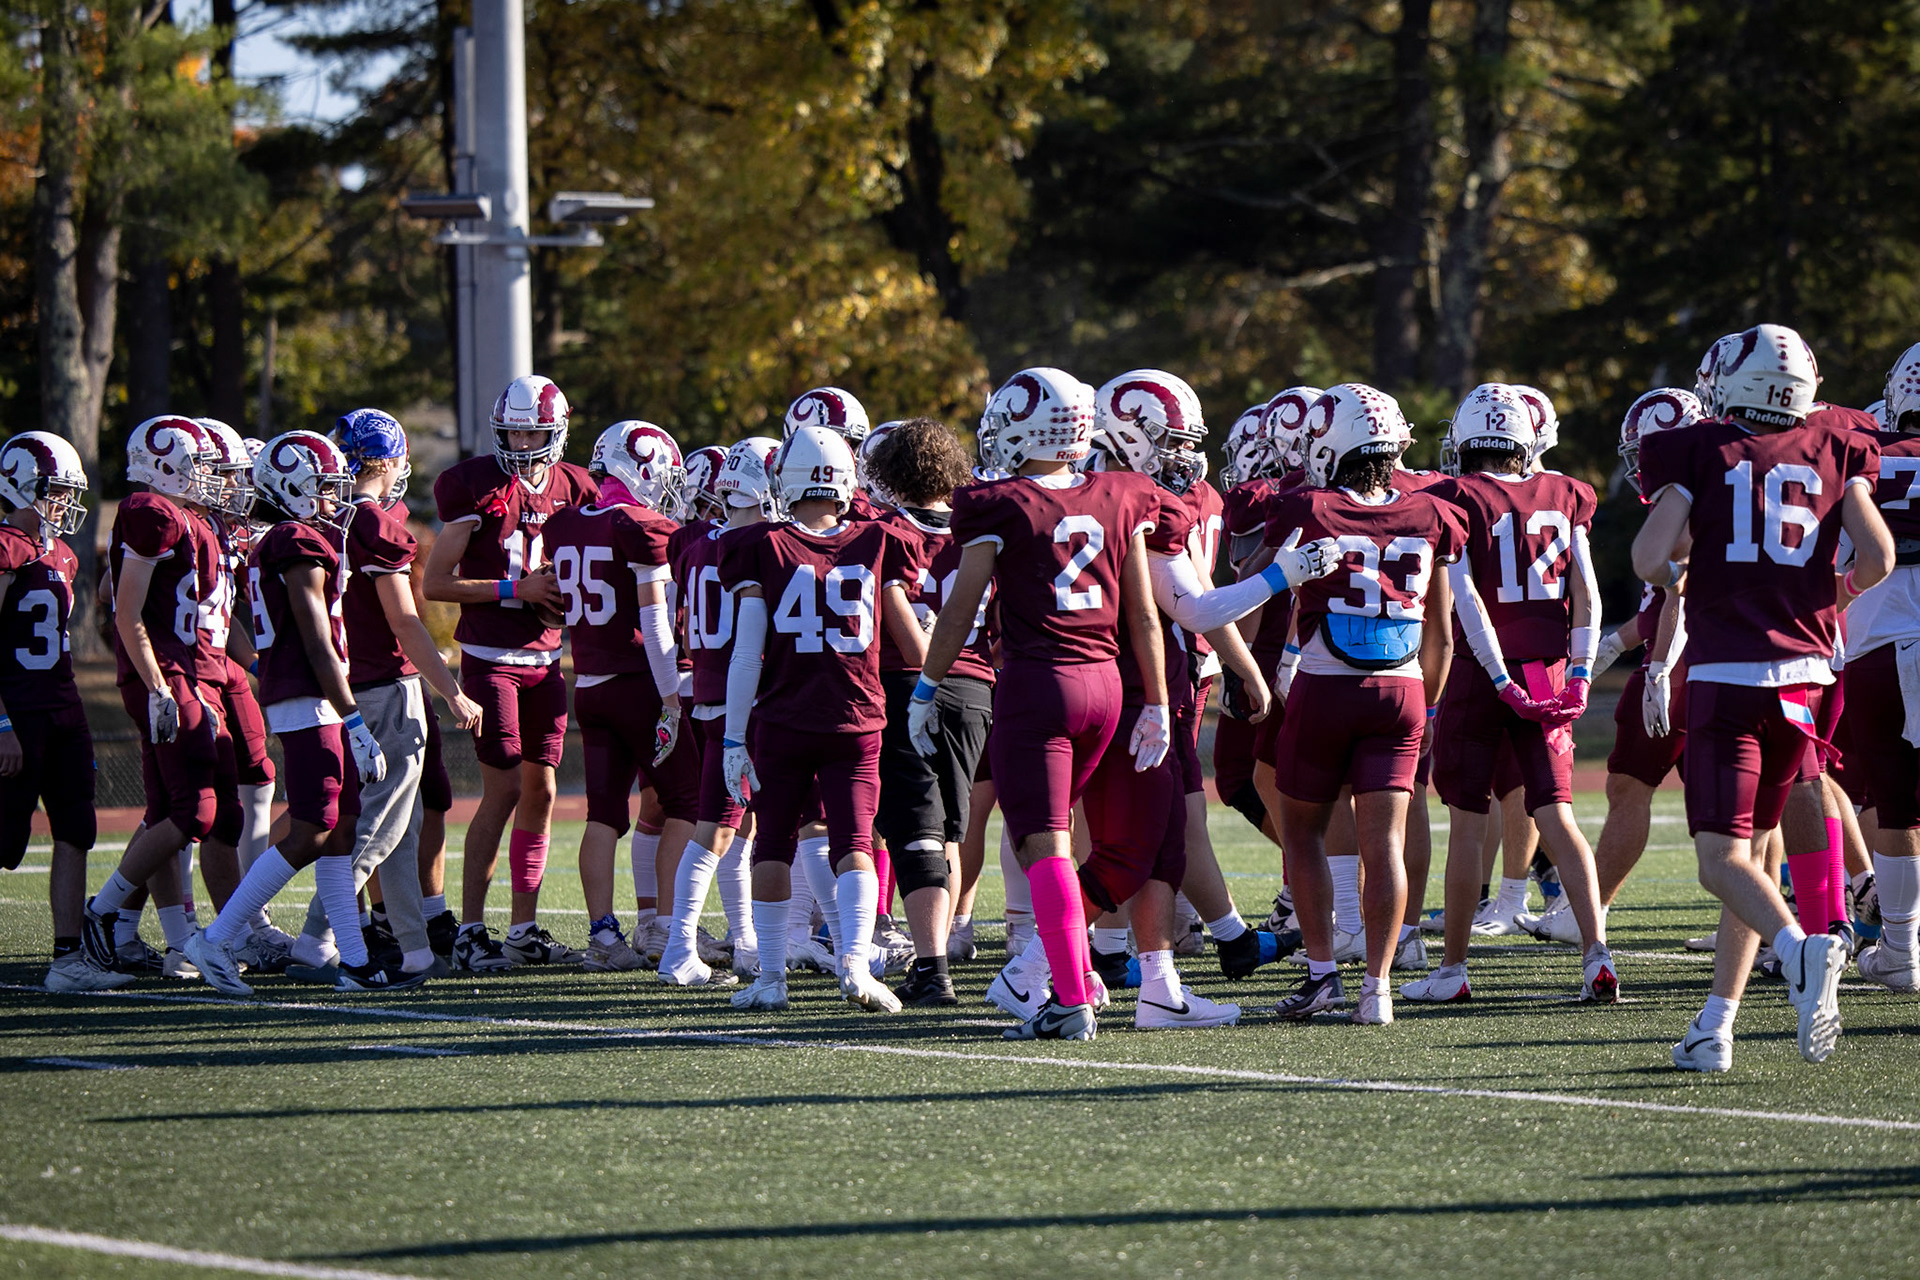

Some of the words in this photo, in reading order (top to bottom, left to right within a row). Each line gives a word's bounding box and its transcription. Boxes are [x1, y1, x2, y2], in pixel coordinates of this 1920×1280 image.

[1766, 384, 1793, 407] 16
[1485, 412, 1506, 431] 12
[1745, 408, 1796, 426] Riddell
[1077, 423, 1086, 441] 2
[1361, 442, 1399, 454] Riddell
[1470, 438, 1515, 451] Riddell
[810, 464, 834, 483] 49
[806, 488, 836, 497] schutt
[521, 511, 548, 524] RAMS
[1725, 460, 1823, 567] 16
[1054, 515, 1104, 611] 2
[1492, 510, 1566, 603] 12
[554, 545, 617, 626] 85
[1327, 535, 1433, 621] 33
[773, 564, 875, 653] 49
[15, 589, 76, 670] 3
